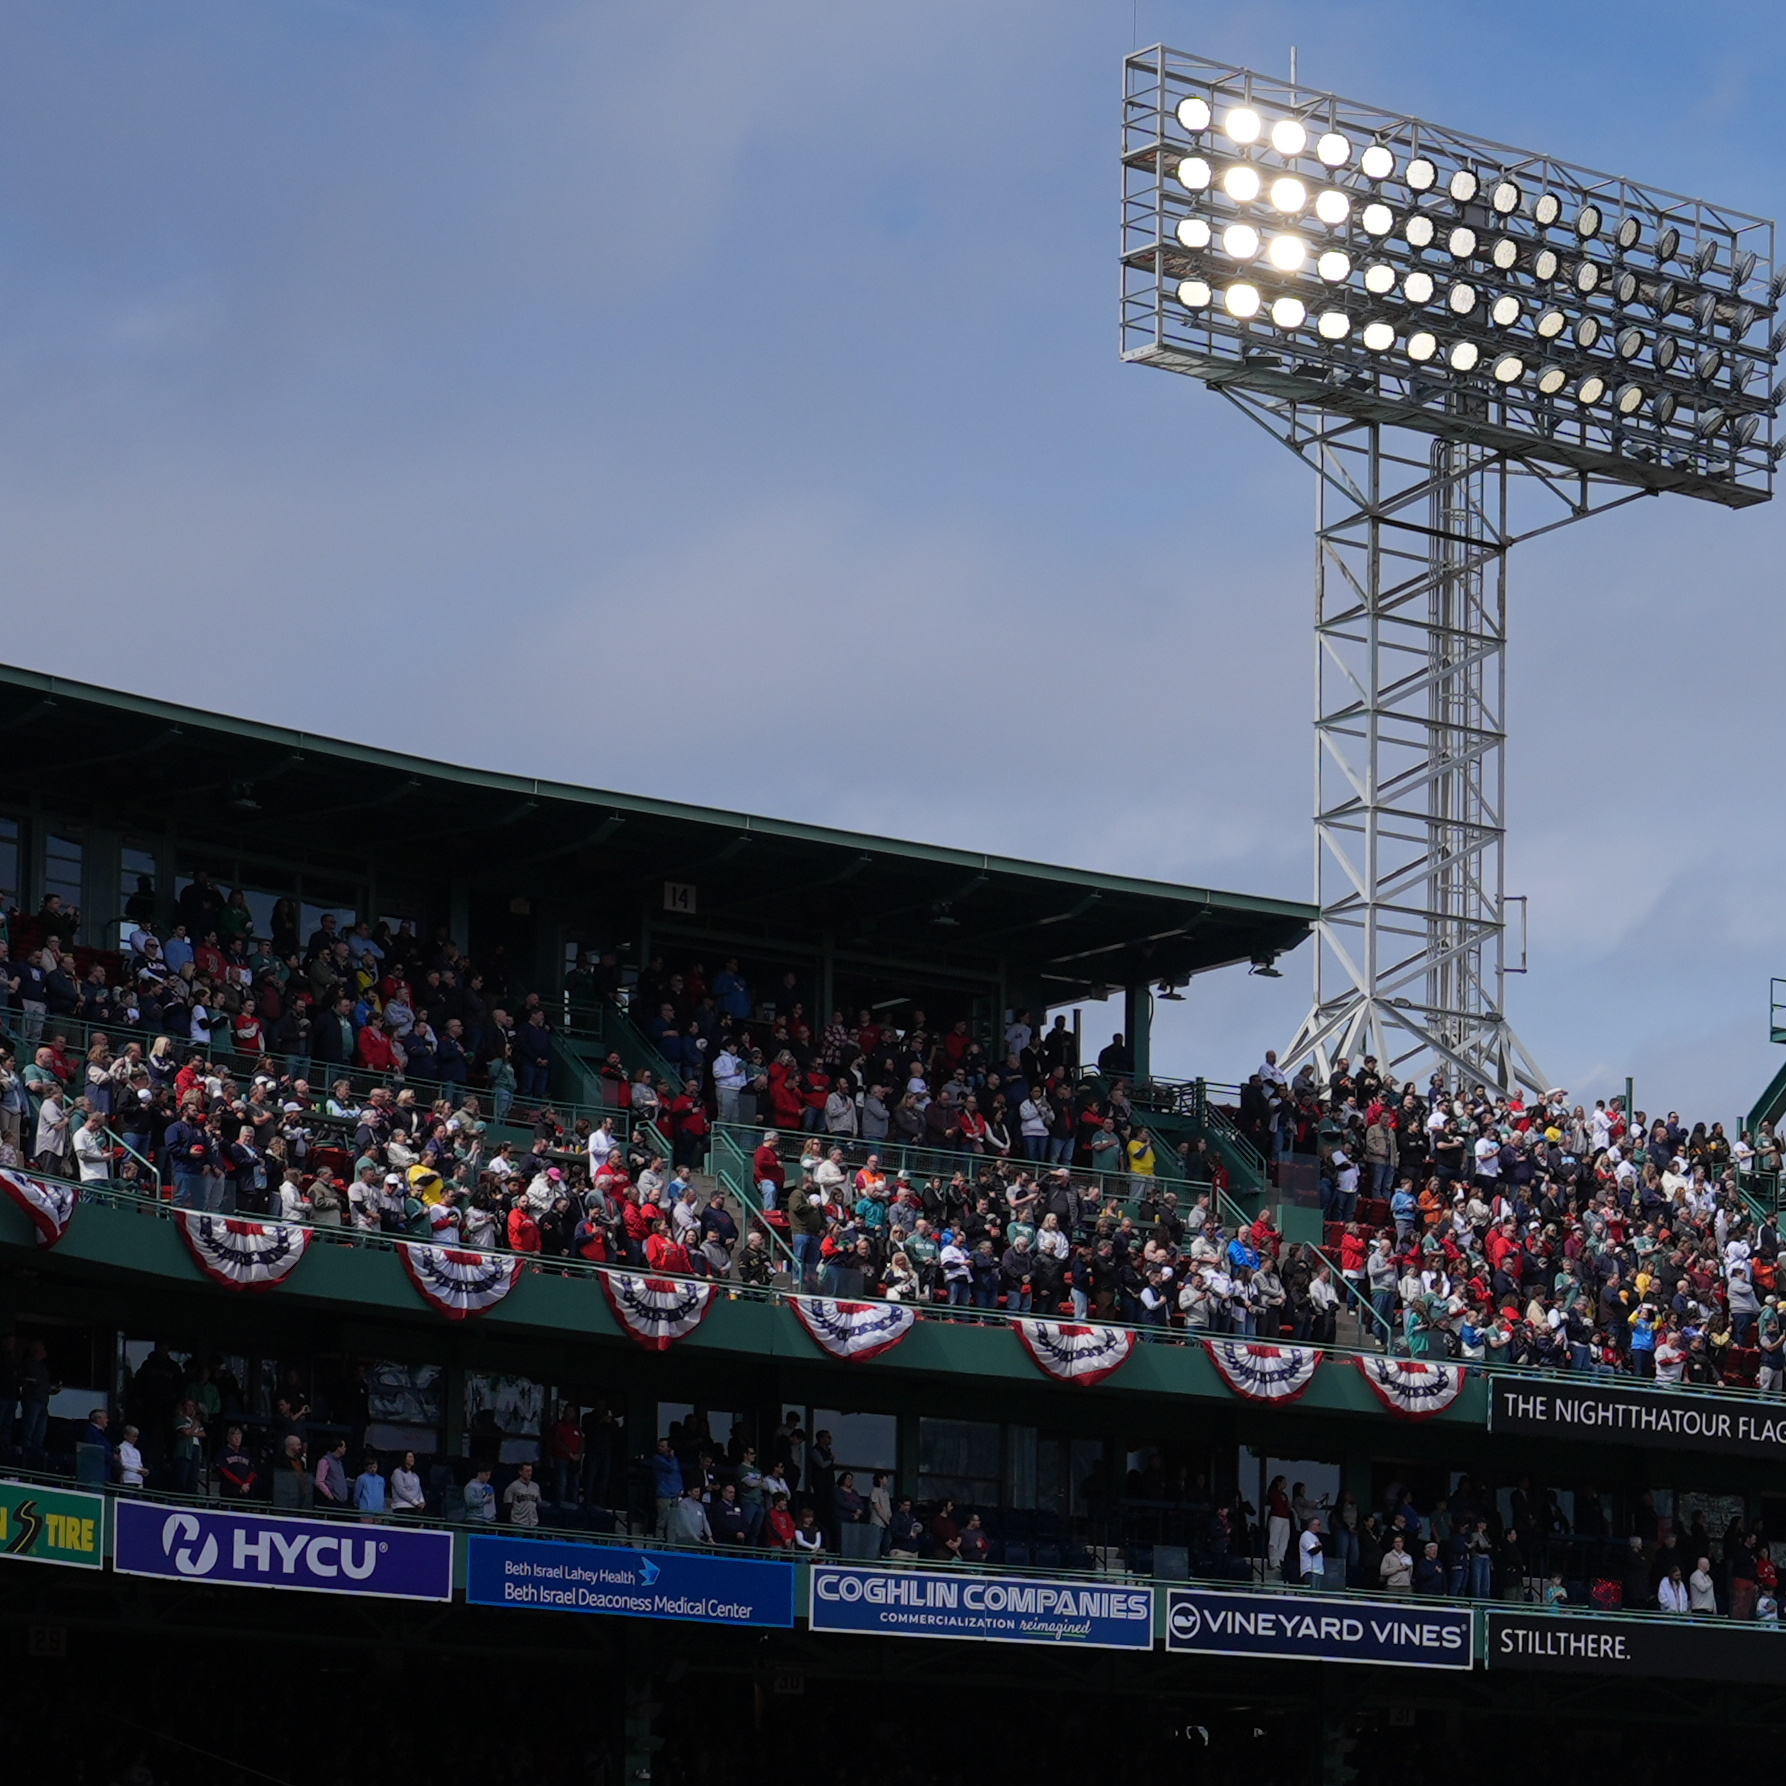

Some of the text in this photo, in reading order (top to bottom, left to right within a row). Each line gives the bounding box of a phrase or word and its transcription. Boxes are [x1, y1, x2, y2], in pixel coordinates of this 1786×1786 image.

[671, 887, 689, 909] 14
[1503, 1392, 1547, 1420] THE
[1555, 1397, 1732, 1438] NIGHTTHATOUR
[46, 1513, 95, 1552] TIRE
[233, 1528, 377, 1580] HYCU
[505, 1560, 636, 1586] Beth Israel Lahey Health
[504, 1581, 753, 1620] Beth Israel Deaconess Medical Center
[817, 1574, 1148, 1620] COGHLIN COMPANIES
[880, 1611, 1091, 1641] COMMERCIALIZATION reimagined
[1203, 1608, 1462, 1650] VINEYARD VINES
[1500, 1628, 1632, 1660] STILLTHERE.
